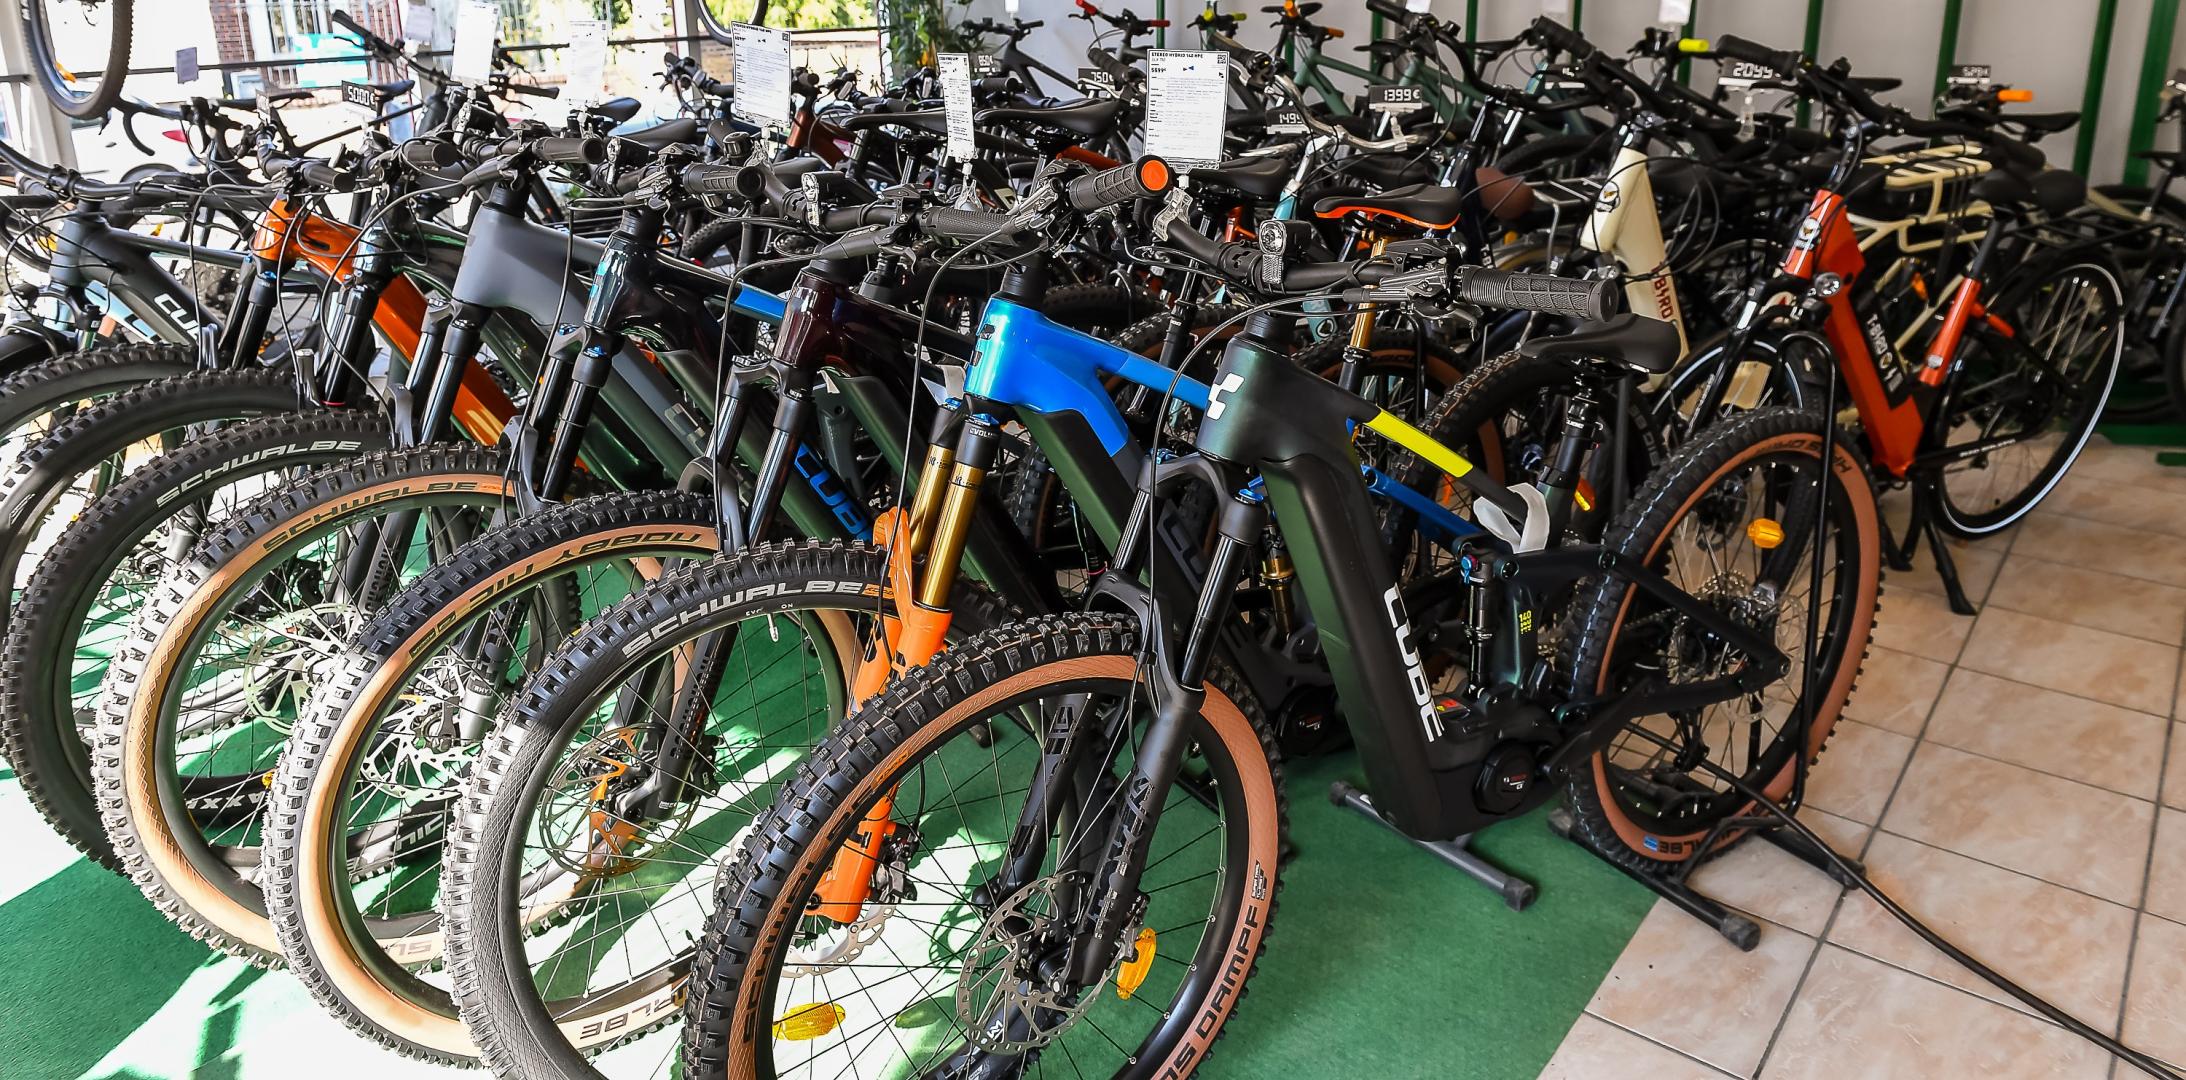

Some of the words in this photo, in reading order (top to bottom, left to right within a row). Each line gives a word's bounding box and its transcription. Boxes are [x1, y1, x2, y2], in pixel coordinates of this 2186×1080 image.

[156, 440, 362, 508] SCHWALBE
[263, 482, 478, 551] SCHWALBE
[555, 532, 702, 562] NOBBY
[469, 564, 534, 604] NIC
[622, 580, 864, 659] SCHWALBE
[1384, 582, 1445, 743] CUBE
[1195, 904, 1259, 1041] DAMPF
